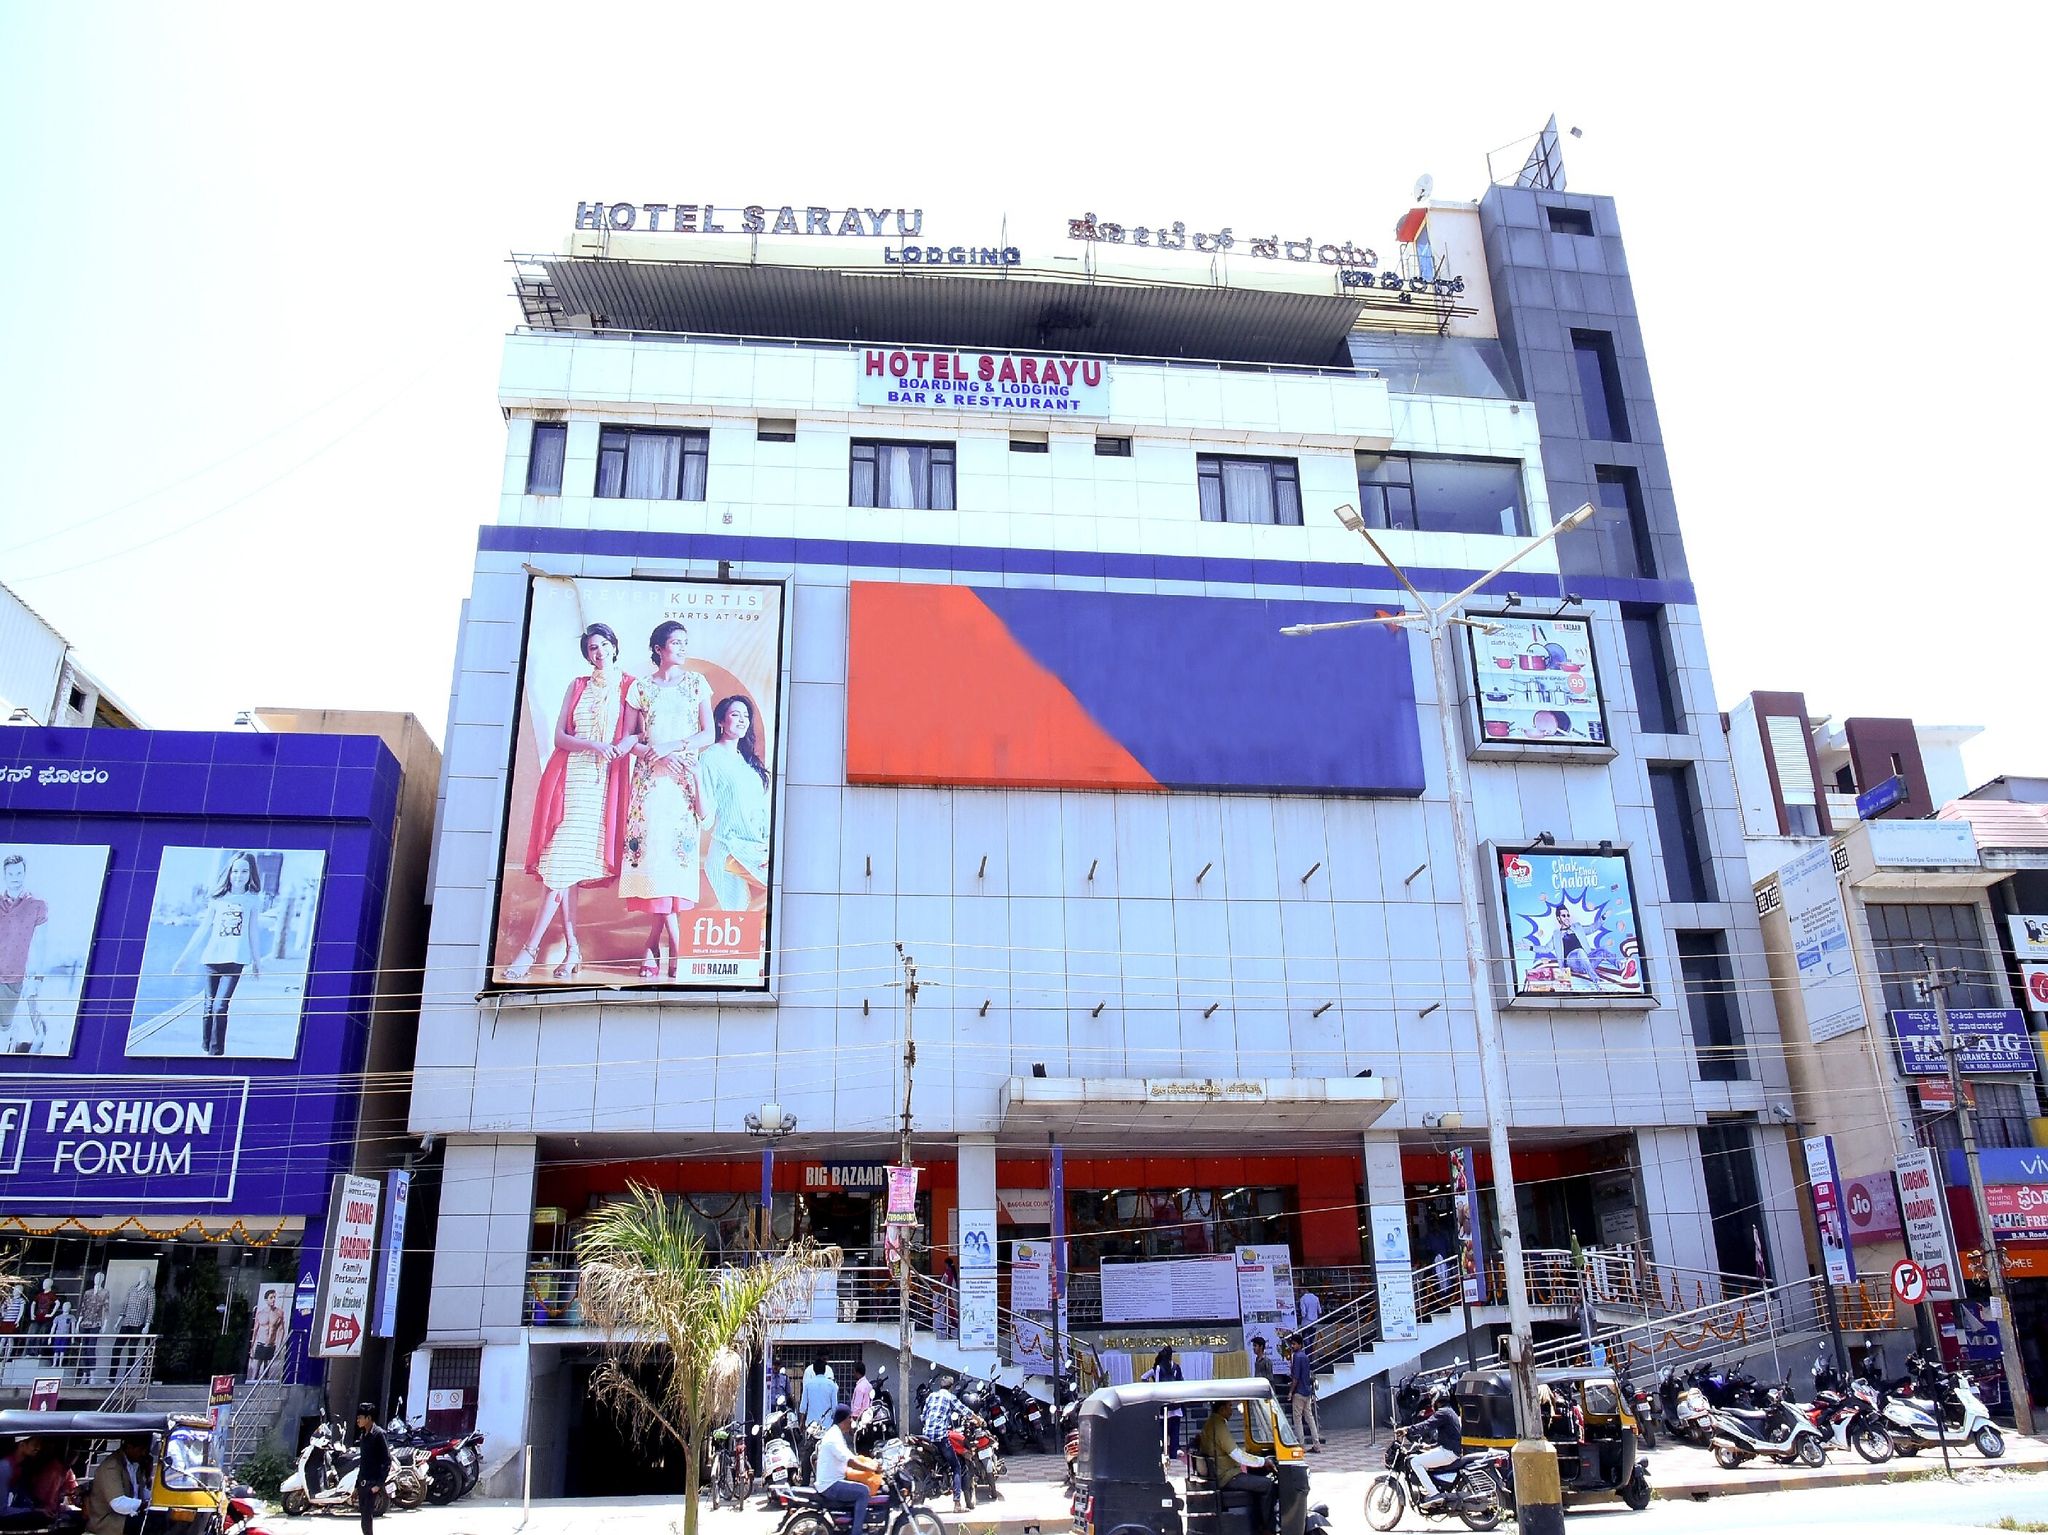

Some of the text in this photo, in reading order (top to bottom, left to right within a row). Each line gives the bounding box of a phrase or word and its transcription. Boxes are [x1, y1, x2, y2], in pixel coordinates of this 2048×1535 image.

[576, 201, 922, 236] HOTEL SARAYU
[884, 246, 1021, 265] LODGING
[866, 350, 1102, 387] HOTEL SARAYU
[899, 378, 1070, 397] BOARDING & LODGING
[887, 391, 1081, 411] BAR & RESTAURANT
[670, 593, 757, 606] KURTIS
[664, 612, 710, 620] STARTS
[38, 766, 109, 786] ಫೋರಂ
[1552, 859, 1578, 873] Chak
[692, 917, 741, 946] fbb
[692, 963, 739, 975] BIG BAZAAR
[1906, 1033, 2022, 1053] TAA AIG
[1993, 1053, 2005, 1061] CO.
[46, 1101, 213, 1134] FASHION
[53, 1140, 191, 1175] FORUM
[805, 1166, 883, 1186] BIG BAZAAR
[1900, 1168, 1930, 1192] LODGING
[345, 1200, 374, 1225] LODGING
[1007, 1200, 1034, 1208] BAGGAGE
[1850, 1193, 1871, 1215] Jio
[1904, 1198, 1937, 1221] BOARDING
[1914, 1221, 1933, 1231] Family
[1910, 1230, 1942, 1242] Restaurant
[339, 1236, 371, 1260] BOARDING
[342, 1263, 363, 1273] Family
[334, 1273, 368, 1285] Restaurant
[345, 1286, 354, 1296] AC
[330, 1329, 353, 1342] FLOOR
